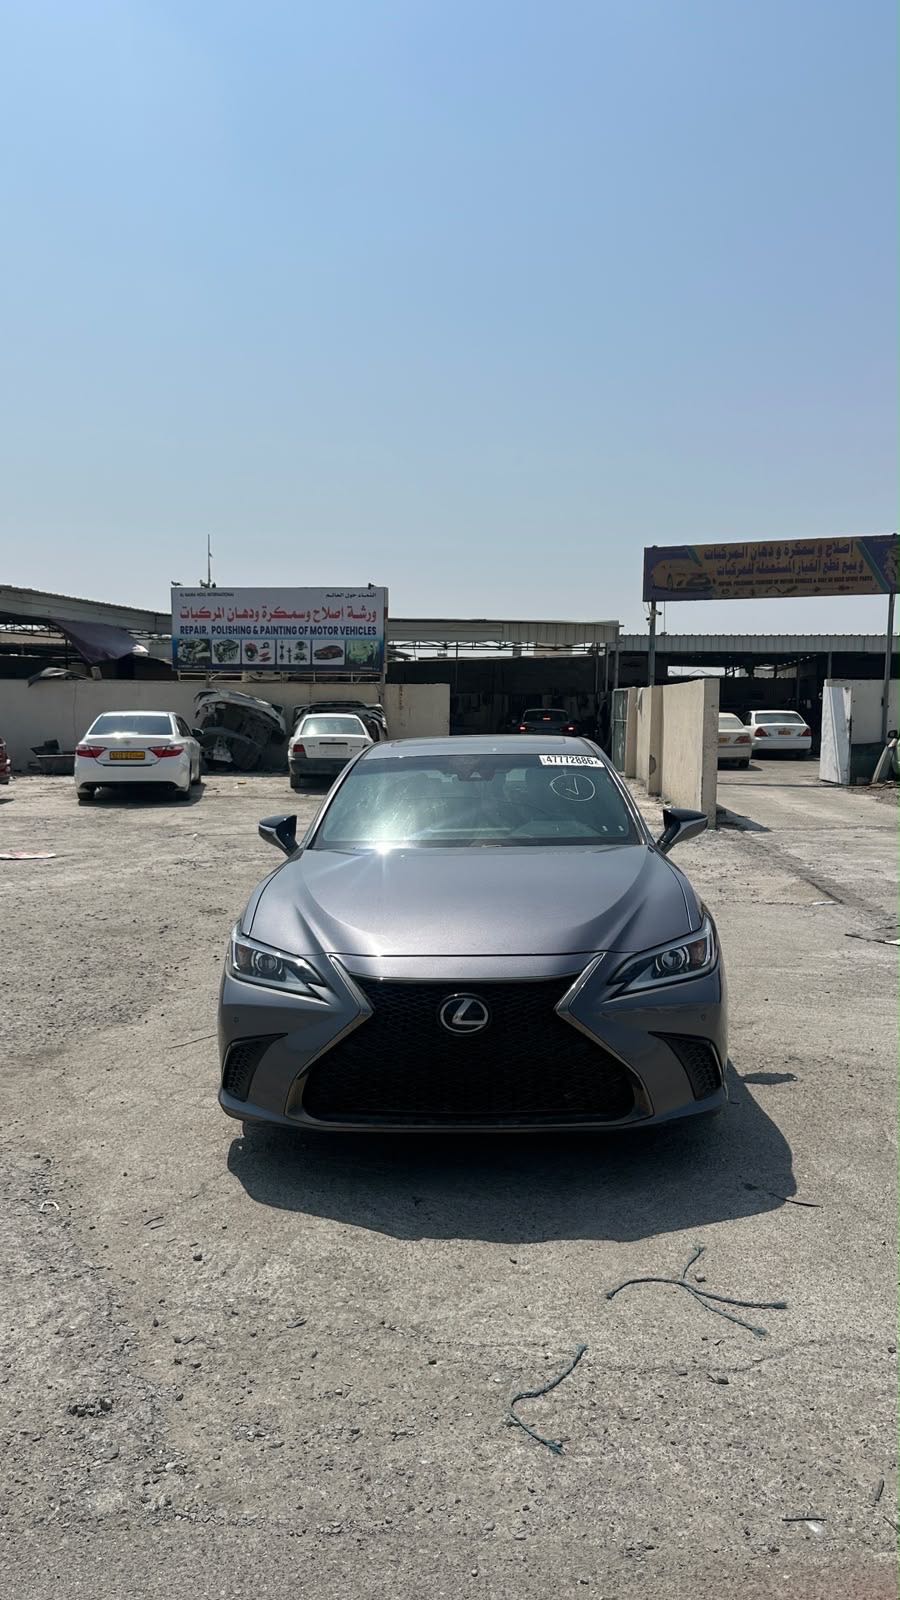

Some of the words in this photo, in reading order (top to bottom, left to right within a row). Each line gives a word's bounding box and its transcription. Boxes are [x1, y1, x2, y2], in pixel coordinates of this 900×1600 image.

[180, 606, 225, 622] المركبات
[347, 605, 377, 622] ورشة
[180, 625, 208, 635] REPAIR,
[211, 625, 252, 635] POLISHING
[252, 625, 259, 635] &
[260, 625, 297, 635] PAINTING
[298, 625, 308, 635] OF
[310, 625, 338, 635] MOTOR
[340, 625, 377, 635] VEHICLES
